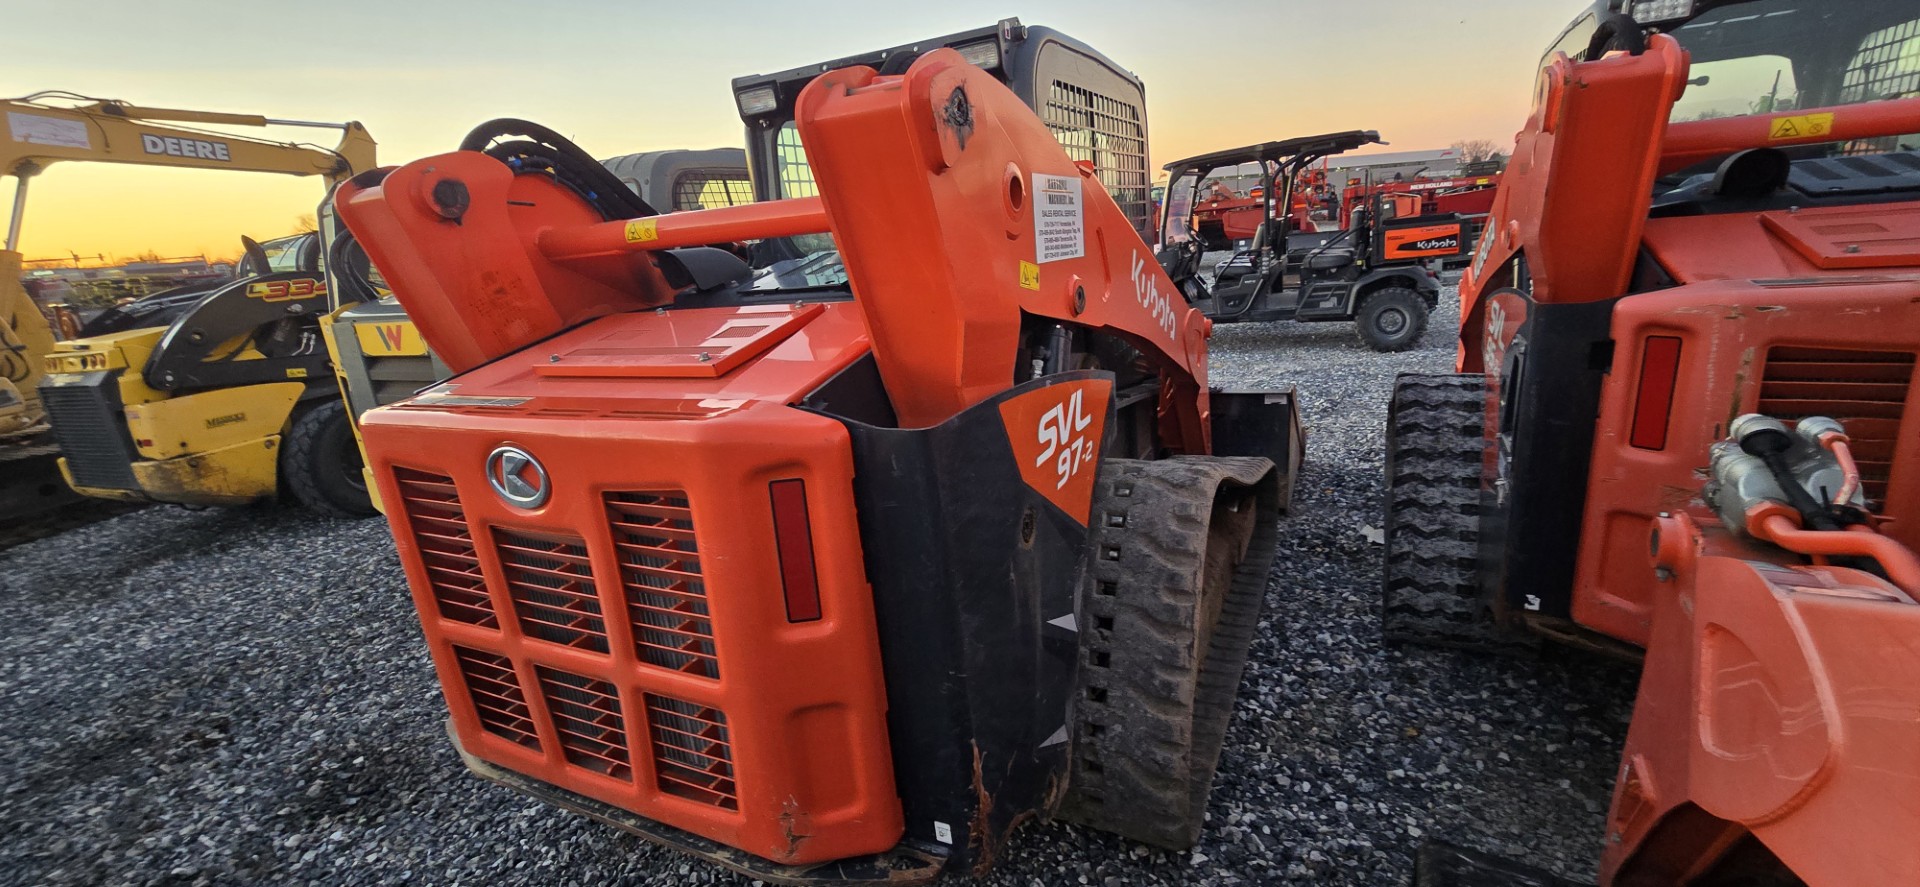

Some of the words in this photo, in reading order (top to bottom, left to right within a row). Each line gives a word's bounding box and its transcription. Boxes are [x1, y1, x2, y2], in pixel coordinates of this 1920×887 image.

[142, 134, 230, 161] DEERE
[1425, 181, 1453, 189] HOLLAND
[1417, 238, 1456, 249] Kubota
[1131, 248, 1176, 341] Kubota
[1036, 388, 1092, 468] SVL
[1057, 435, 1093, 490] 97-2
